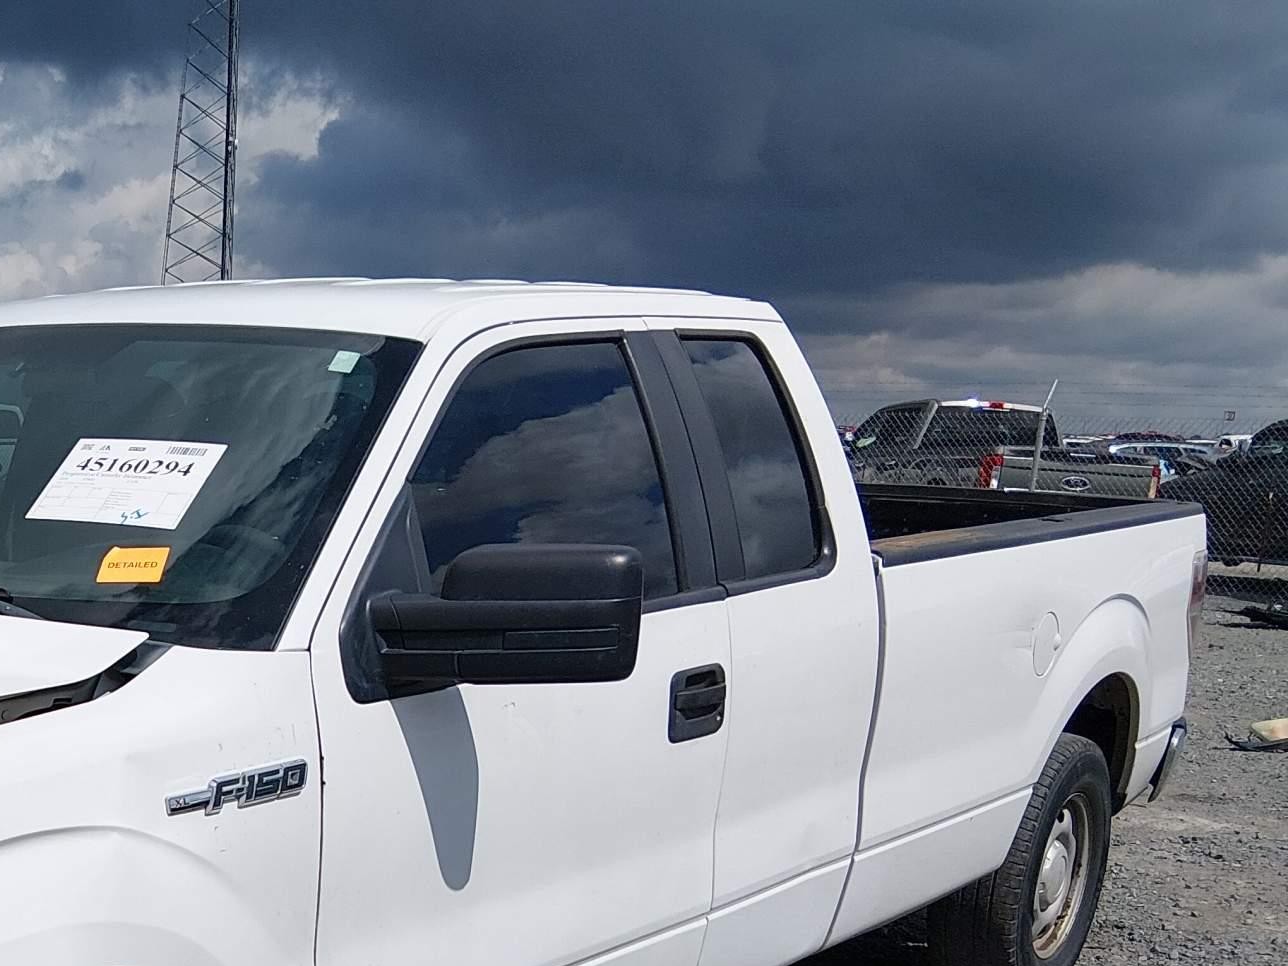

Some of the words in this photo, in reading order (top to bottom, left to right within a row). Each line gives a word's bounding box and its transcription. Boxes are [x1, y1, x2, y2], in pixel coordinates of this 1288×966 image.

[76, 457, 196, 477] 45160294
[107, 560, 158, 570] DETAILED
[205, 758, 308, 817] F-150
